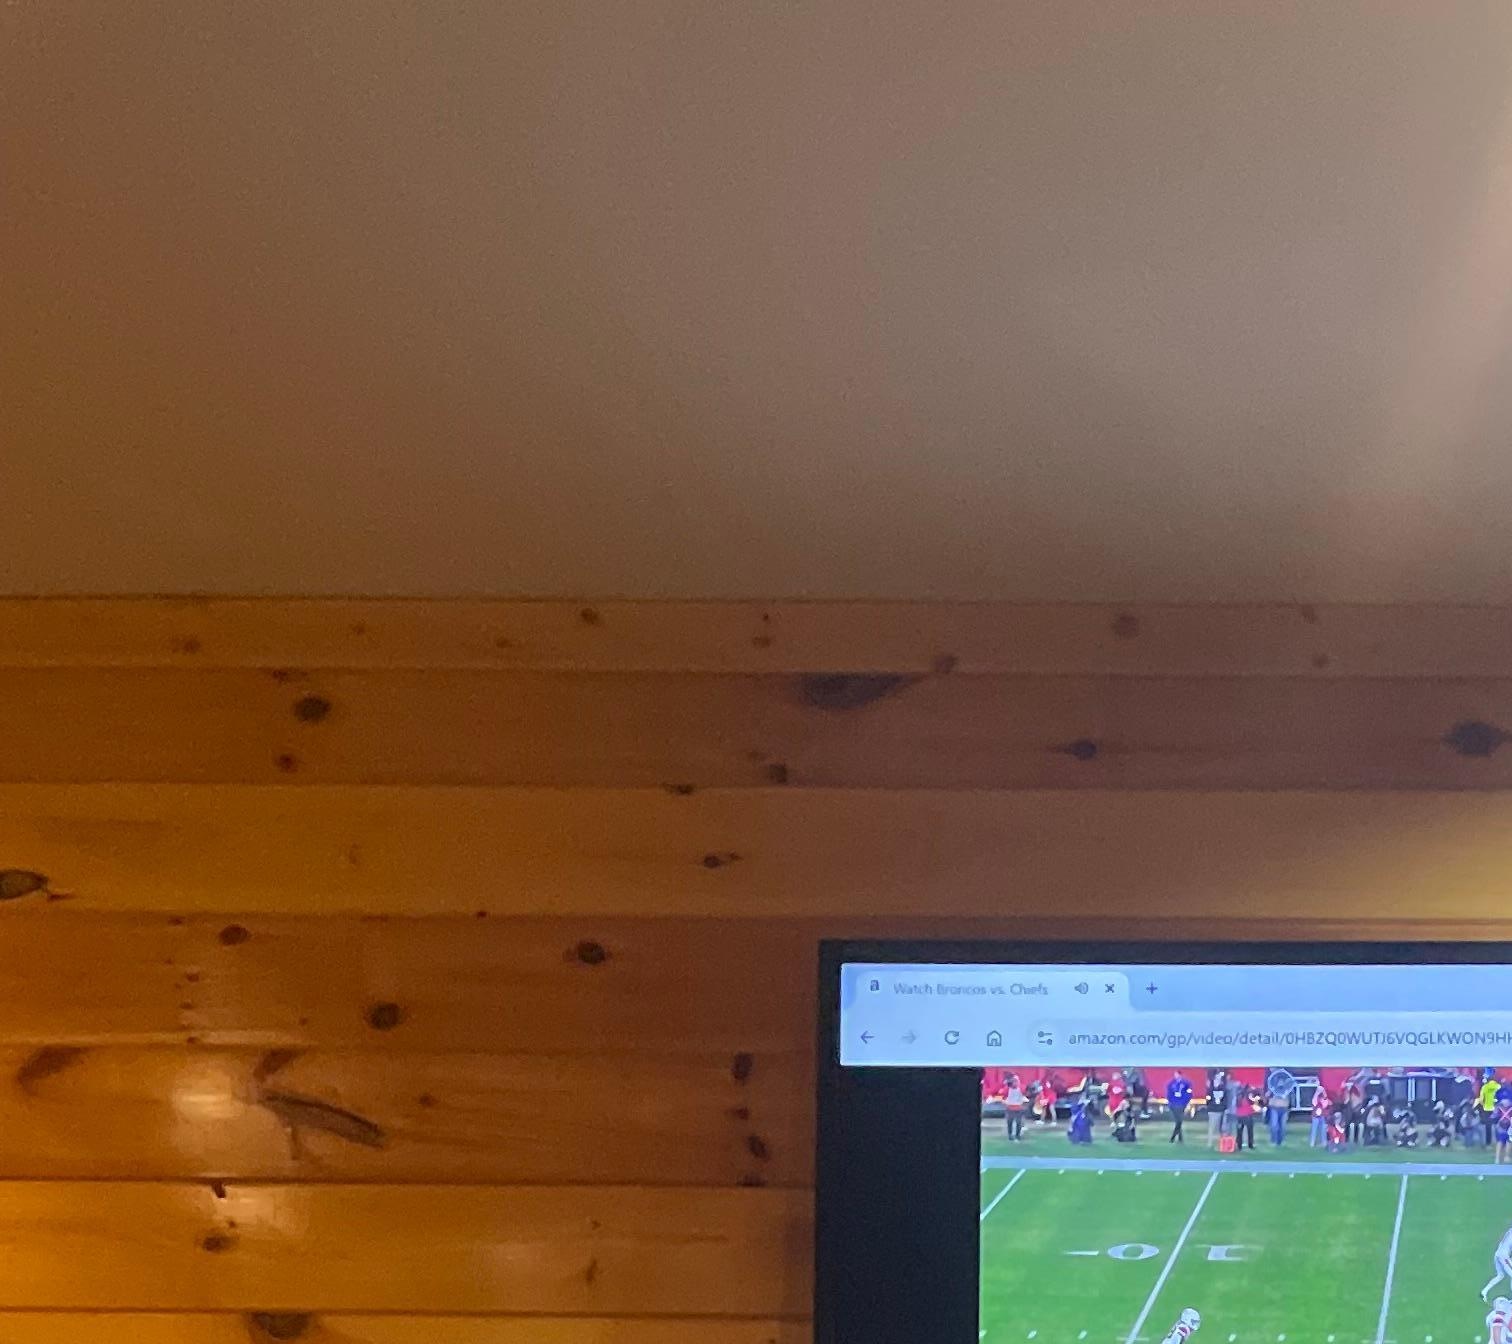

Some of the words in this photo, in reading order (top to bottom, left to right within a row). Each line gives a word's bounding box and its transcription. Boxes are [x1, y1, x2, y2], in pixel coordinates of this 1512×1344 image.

[893, 983, 933, 996] Watch
[936, 983, 987, 996] Broncos
[1009, 982, 1049, 996] Chiefs
